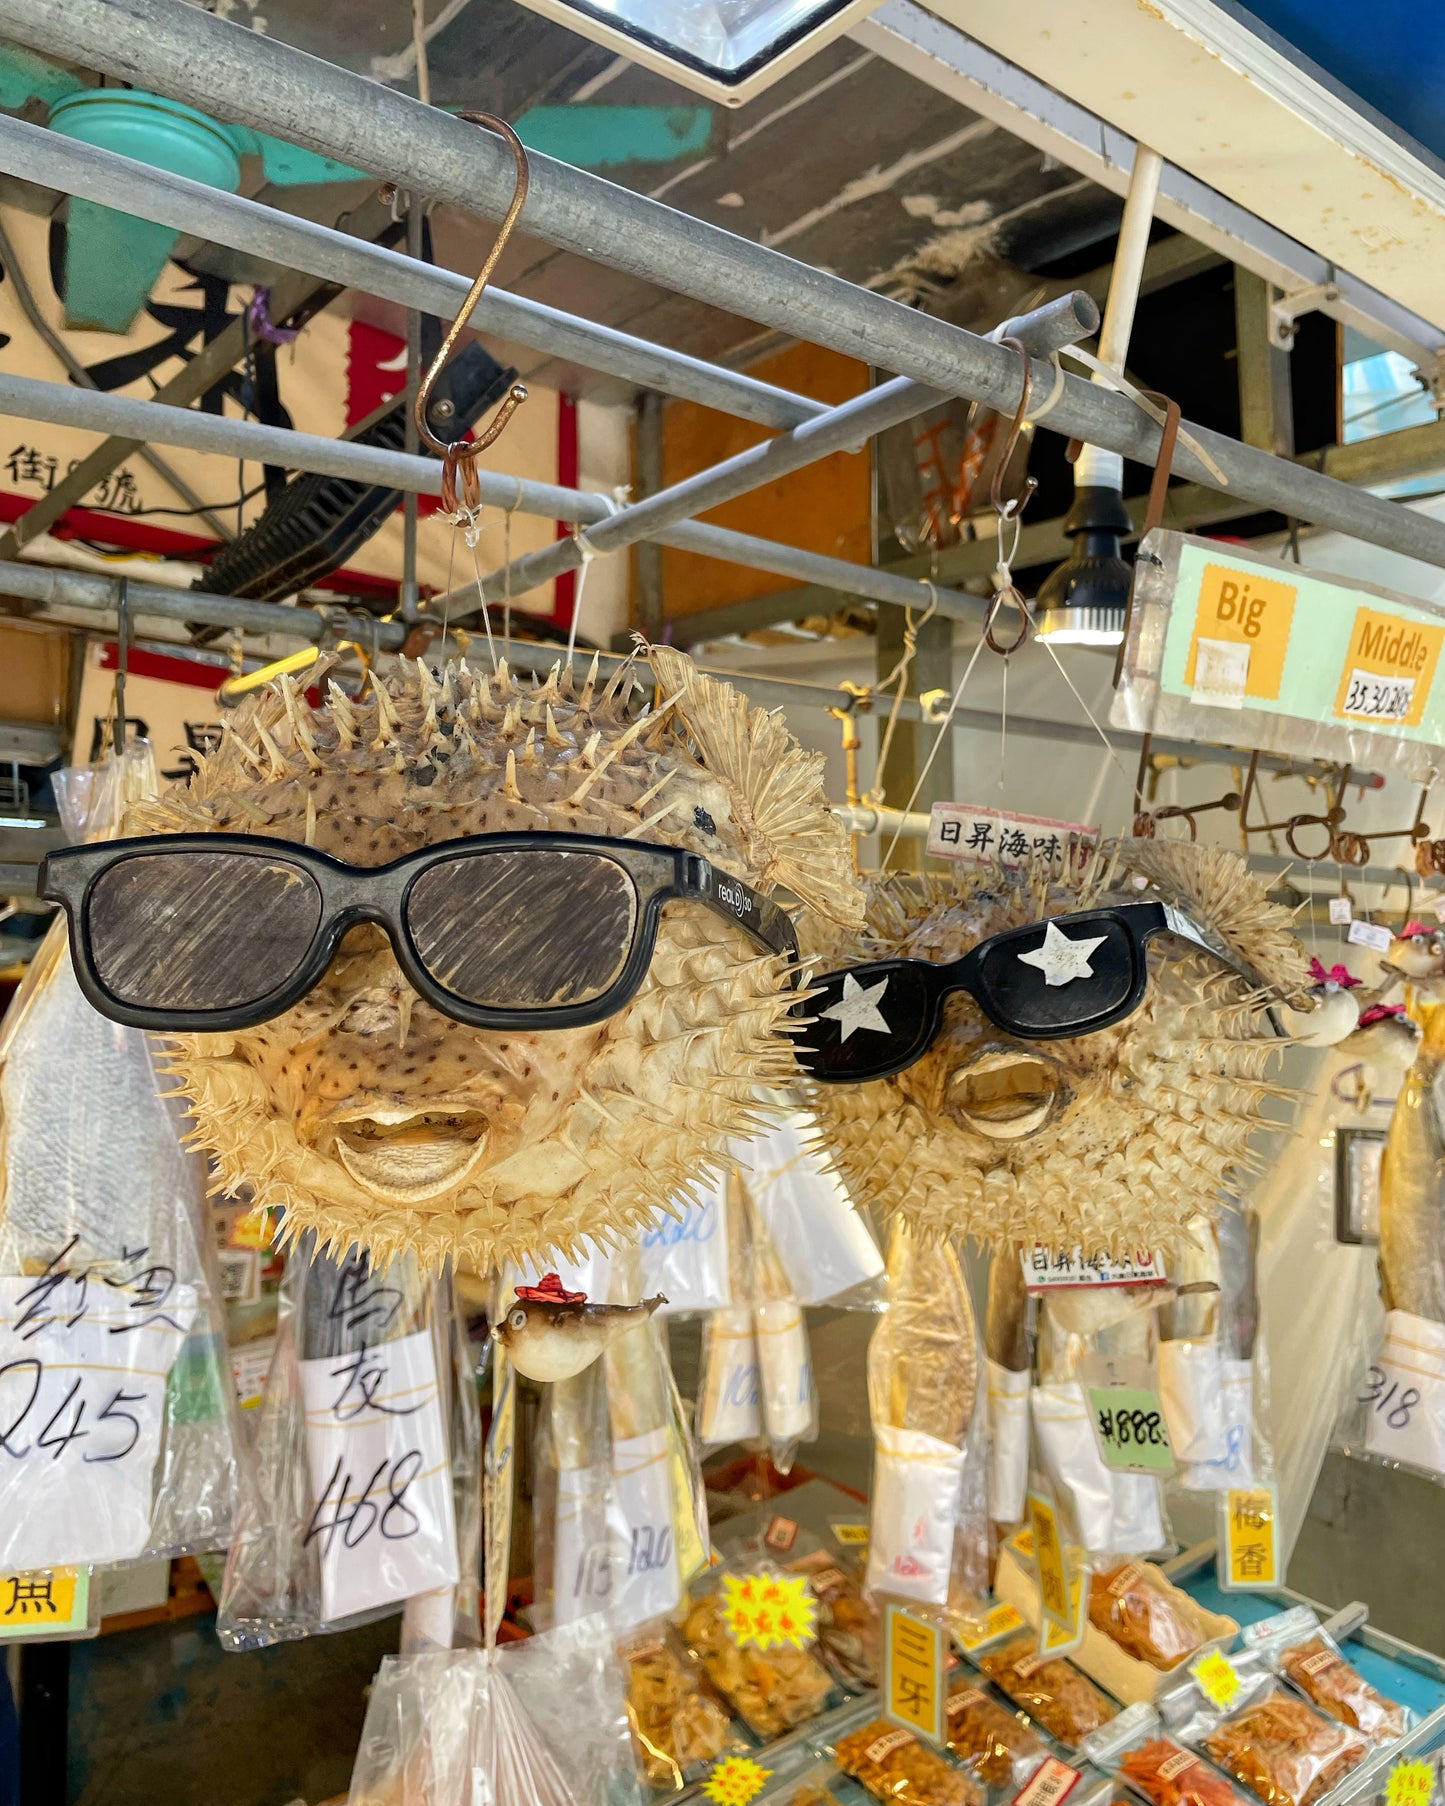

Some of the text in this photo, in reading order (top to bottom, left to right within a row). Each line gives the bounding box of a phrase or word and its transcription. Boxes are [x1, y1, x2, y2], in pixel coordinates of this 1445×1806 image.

[1215, 580, 1268, 639] Big
[1357, 621, 1428, 671] Middle
[940, 821, 1063, 862] 日昇海味
[0, 1358, 147, 1462] 245
[1356, 1366, 1421, 1429] 318
[303, 1450, 422, 1561] 468
